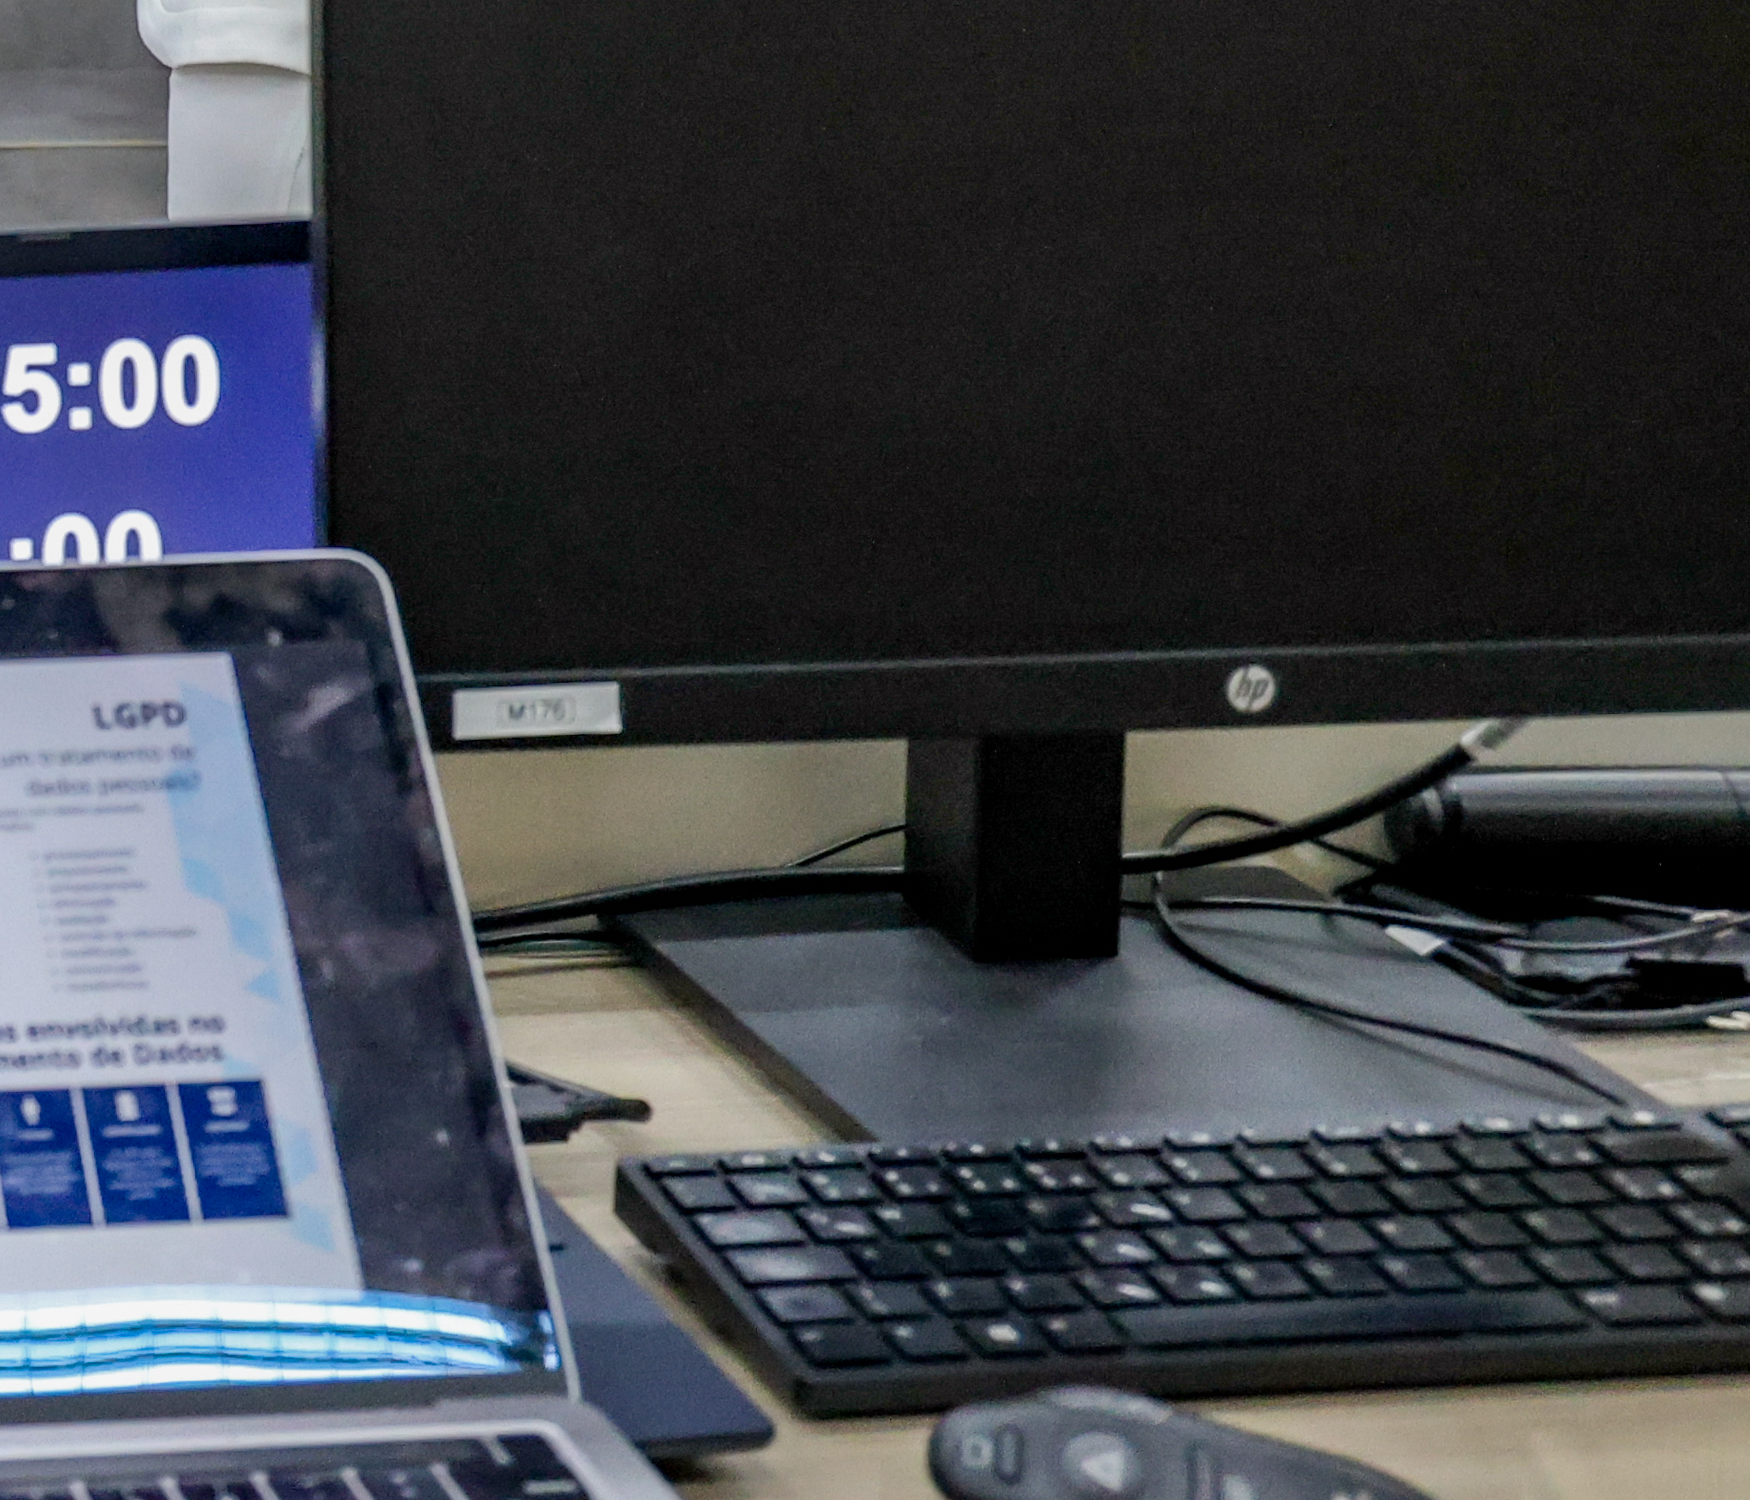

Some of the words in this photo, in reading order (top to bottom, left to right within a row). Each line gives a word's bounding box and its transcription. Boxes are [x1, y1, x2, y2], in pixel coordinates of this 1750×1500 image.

[91, 700, 188, 731] LGPD
[37, 744, 162, 767] tratamento
[26, 778, 92, 799] dados
[26, 1014, 181, 1042] envolvidas
[187, 1015, 227, 1036] no
[91, 1045, 127, 1071] de
[133, 1041, 225, 1068] Dados
